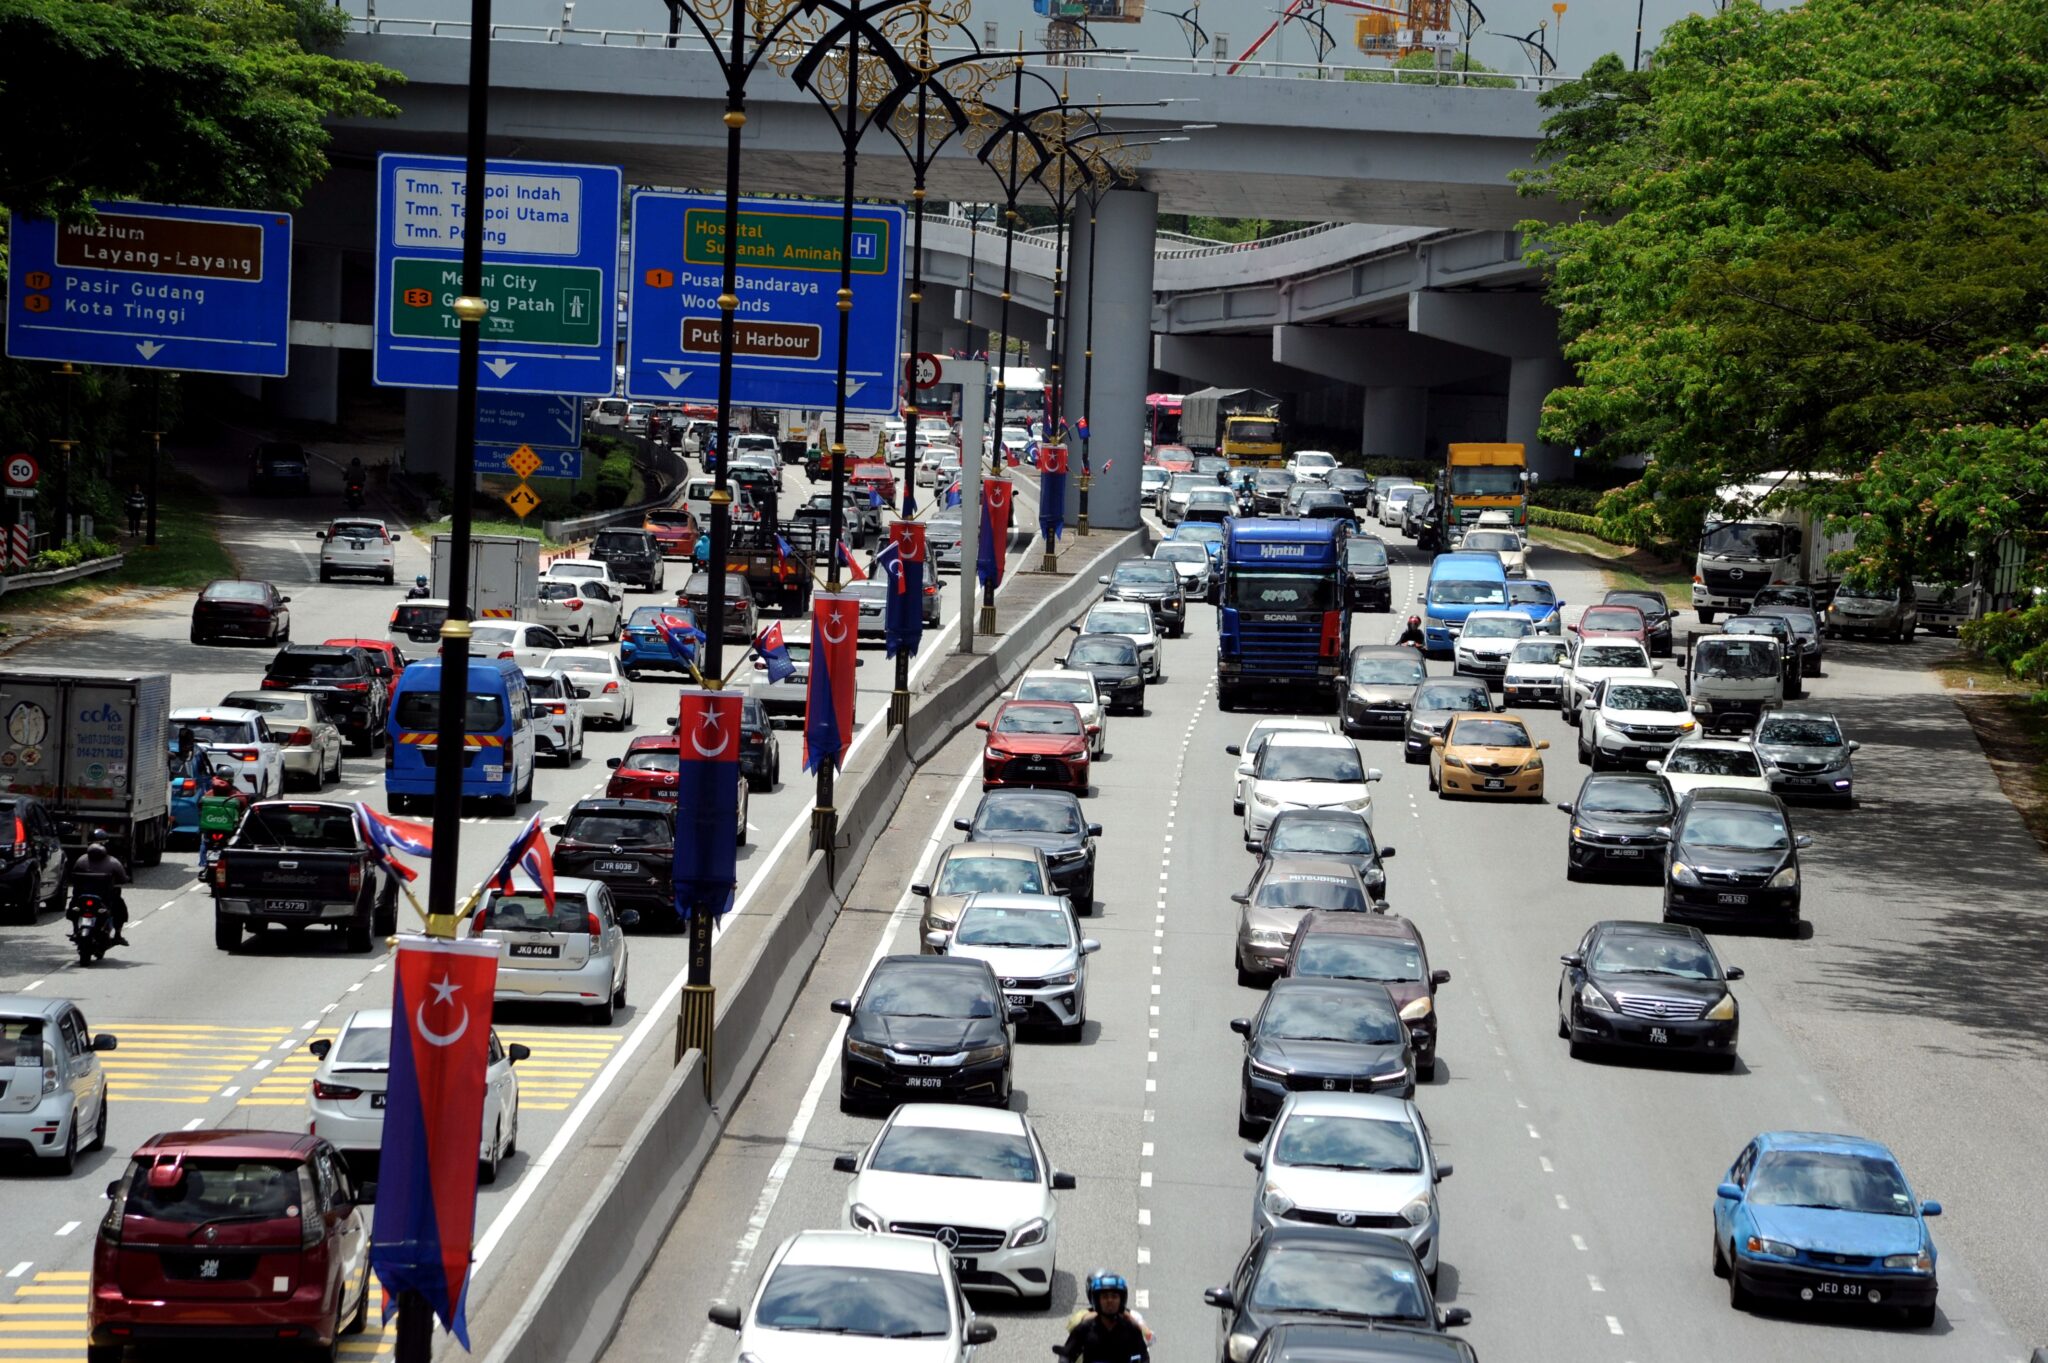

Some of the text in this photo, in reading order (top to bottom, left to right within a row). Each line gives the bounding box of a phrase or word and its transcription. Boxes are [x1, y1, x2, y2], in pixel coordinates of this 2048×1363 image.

[406, 179, 561, 201] Tmn. Tapoi Indah
[405, 201, 569, 223] Tmn. Tapoi Utama
[67, 224, 145, 241] Muzium
[405, 224, 506, 245] Tmn. Peing
[695, 220, 763, 239] Hosital
[705, 240, 842, 262] Suanah Aminah
[857, 237, 870, 256] H
[84, 244, 252, 274] Layang-Layang
[32, 274, 44, 286] 17
[442, 271, 537, 292] Meni City
[656, 273, 663, 285] 1
[735, 275, 819, 294] Bandaraya
[66, 276, 205, 305] Pasir Gudang
[408, 292, 429, 303] E3
[33, 298, 41, 309] 3
[507, 297, 555, 313] Patah
[65, 299, 186, 325] Kota Tinggi
[746, 331, 810, 348] Harbour
[12, 465, 30, 477] 50
[206, 814, 229, 824] Grab
[600, 862, 614, 870] JYR
[1289, 874, 1347, 886] MITSUBISHI
[269, 901, 284, 909] JLC
[533, 945, 552, 955] 4044
[905, 1077, 922, 1088] JRW
[1817, 1283, 1862, 1295] JED 931
